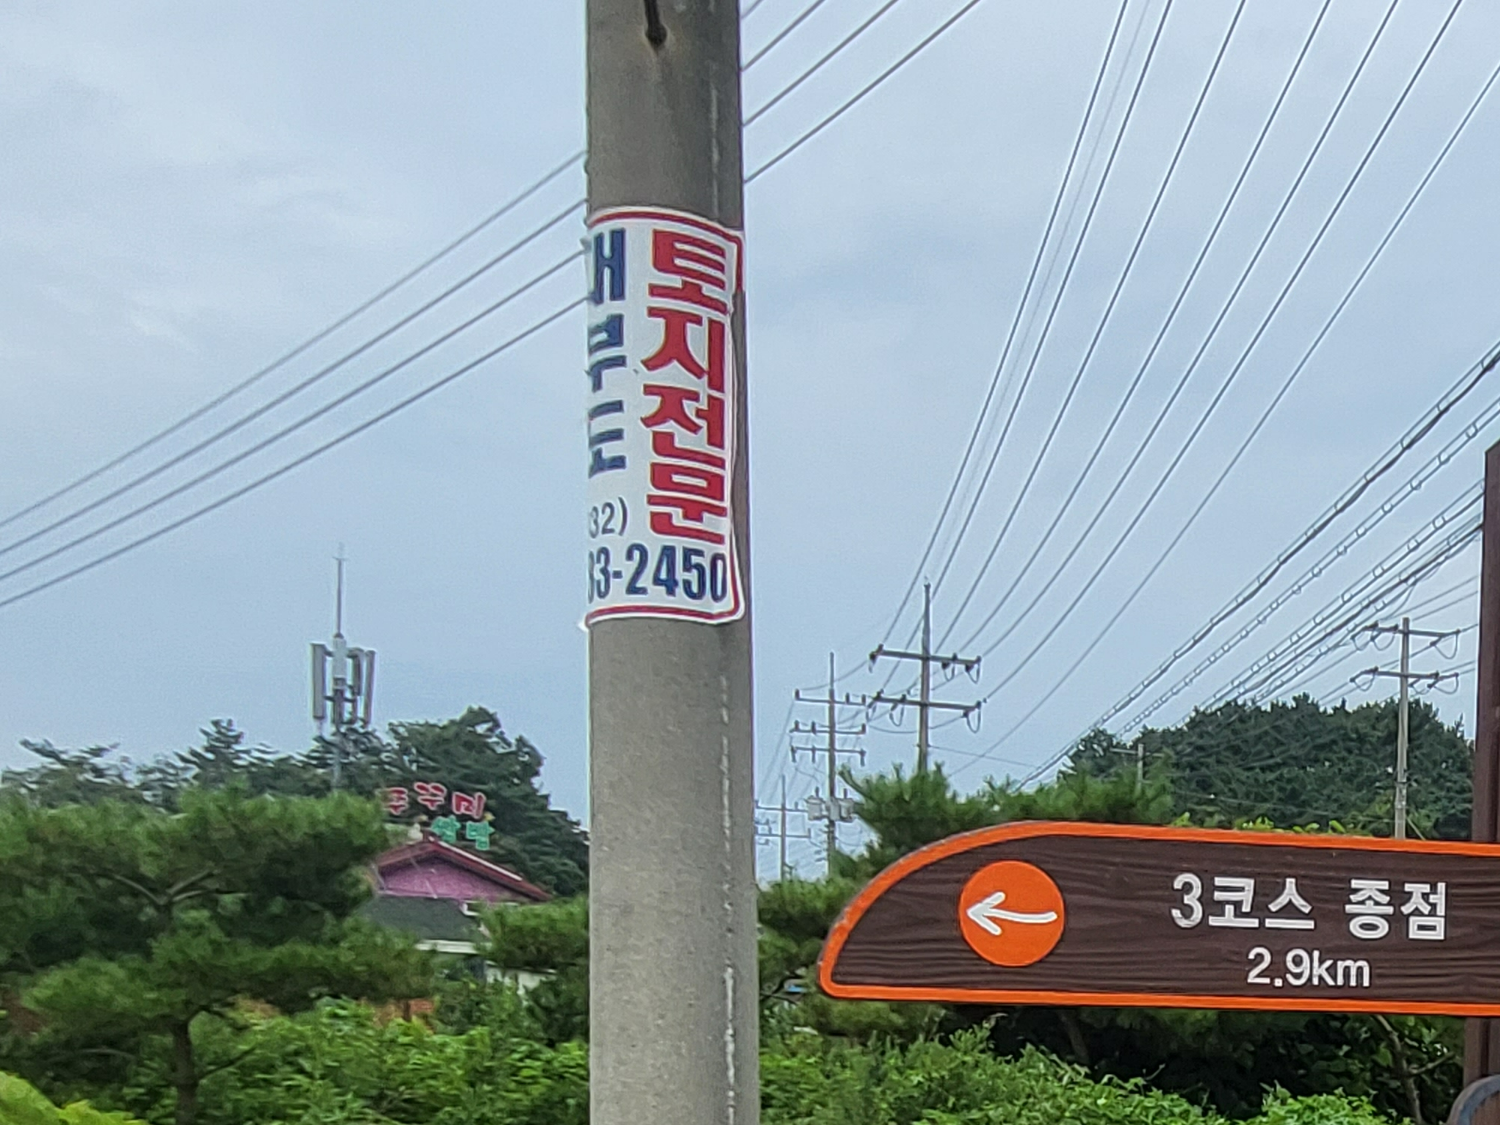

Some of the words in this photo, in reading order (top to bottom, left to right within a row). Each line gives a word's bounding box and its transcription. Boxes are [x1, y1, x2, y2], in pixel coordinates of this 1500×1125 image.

[640, 228, 728, 545] 토지전문
[1171, 873, 1315, 930] 3코스
[1344, 878, 1448, 941] 종점
[1246, 946, 1371, 989] 2.9km
